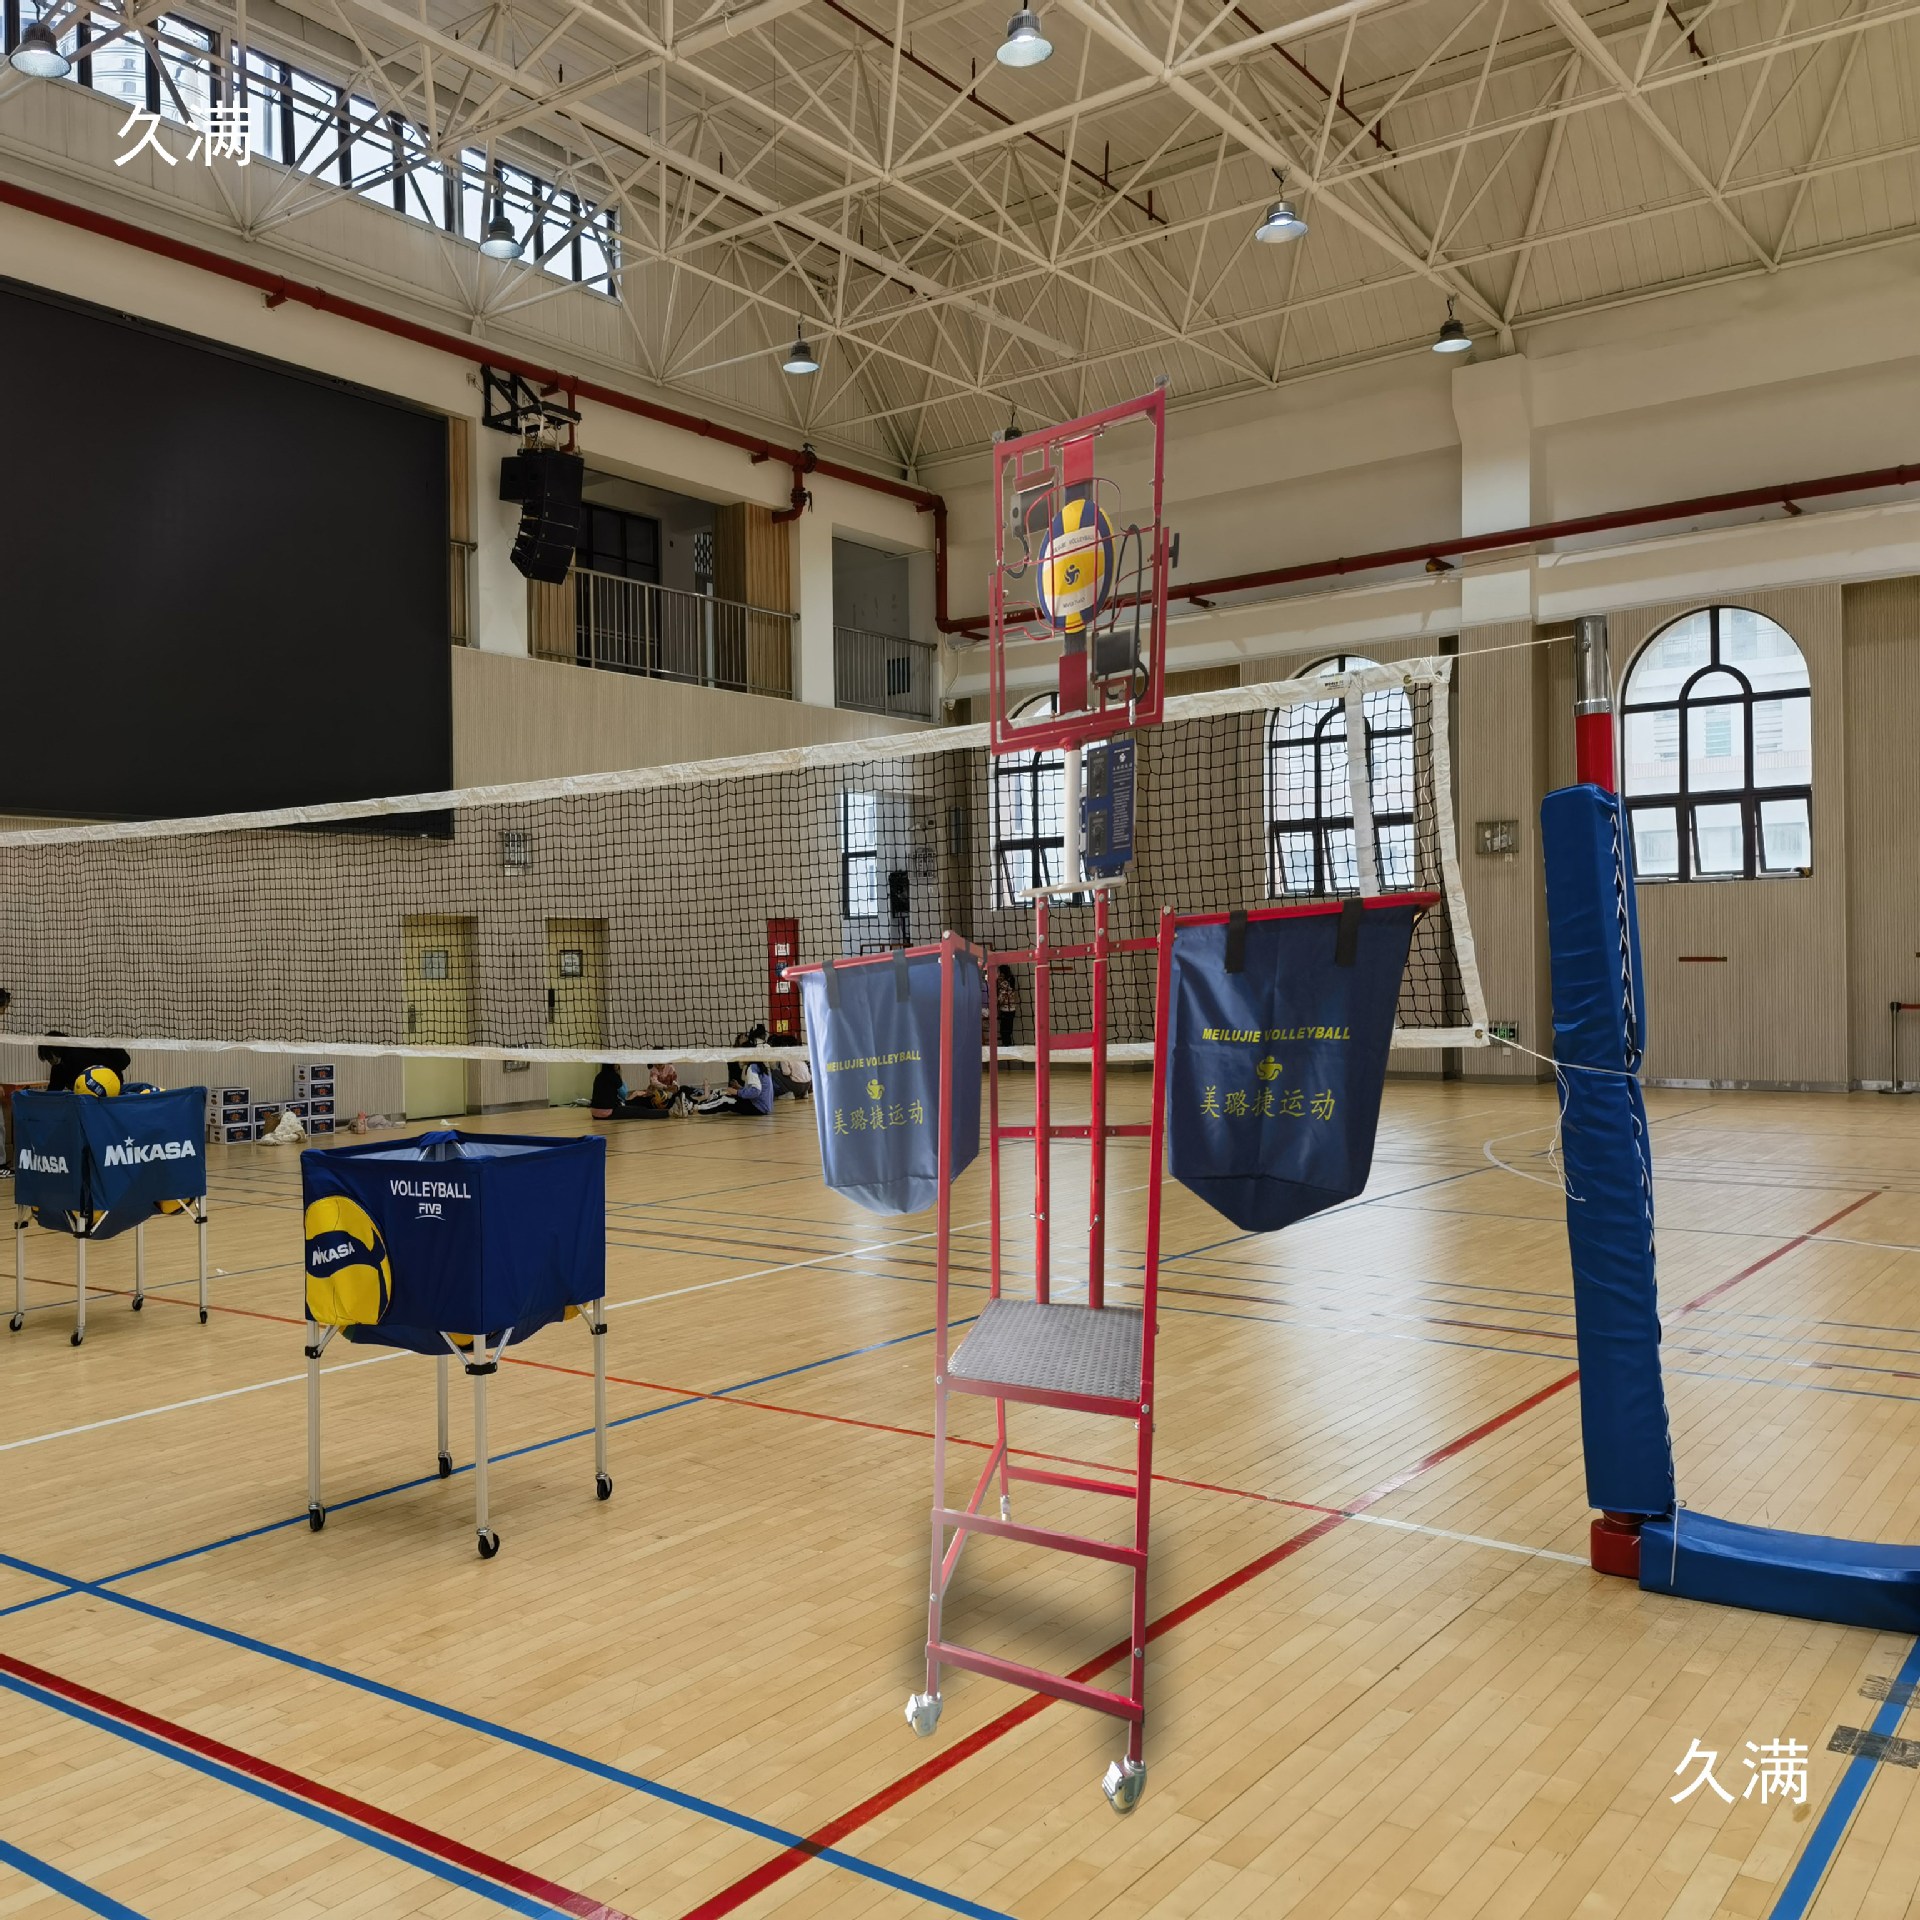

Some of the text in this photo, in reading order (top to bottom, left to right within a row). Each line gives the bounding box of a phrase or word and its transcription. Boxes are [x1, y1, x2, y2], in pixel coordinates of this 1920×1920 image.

[1202, 1026, 1350, 1043] MEILUJIE VOLLEYBALL
[826, 1050, 921, 1072] MEILUJIE VOLLEYBALL
[1200, 1085, 1335, 1121] 美璐捷运动
[834, 1099, 924, 1134] 美璐捷运动
[390, 1180, 472, 1199] VOLLEYBALL
[419, 1203, 441, 1215] FIVB
